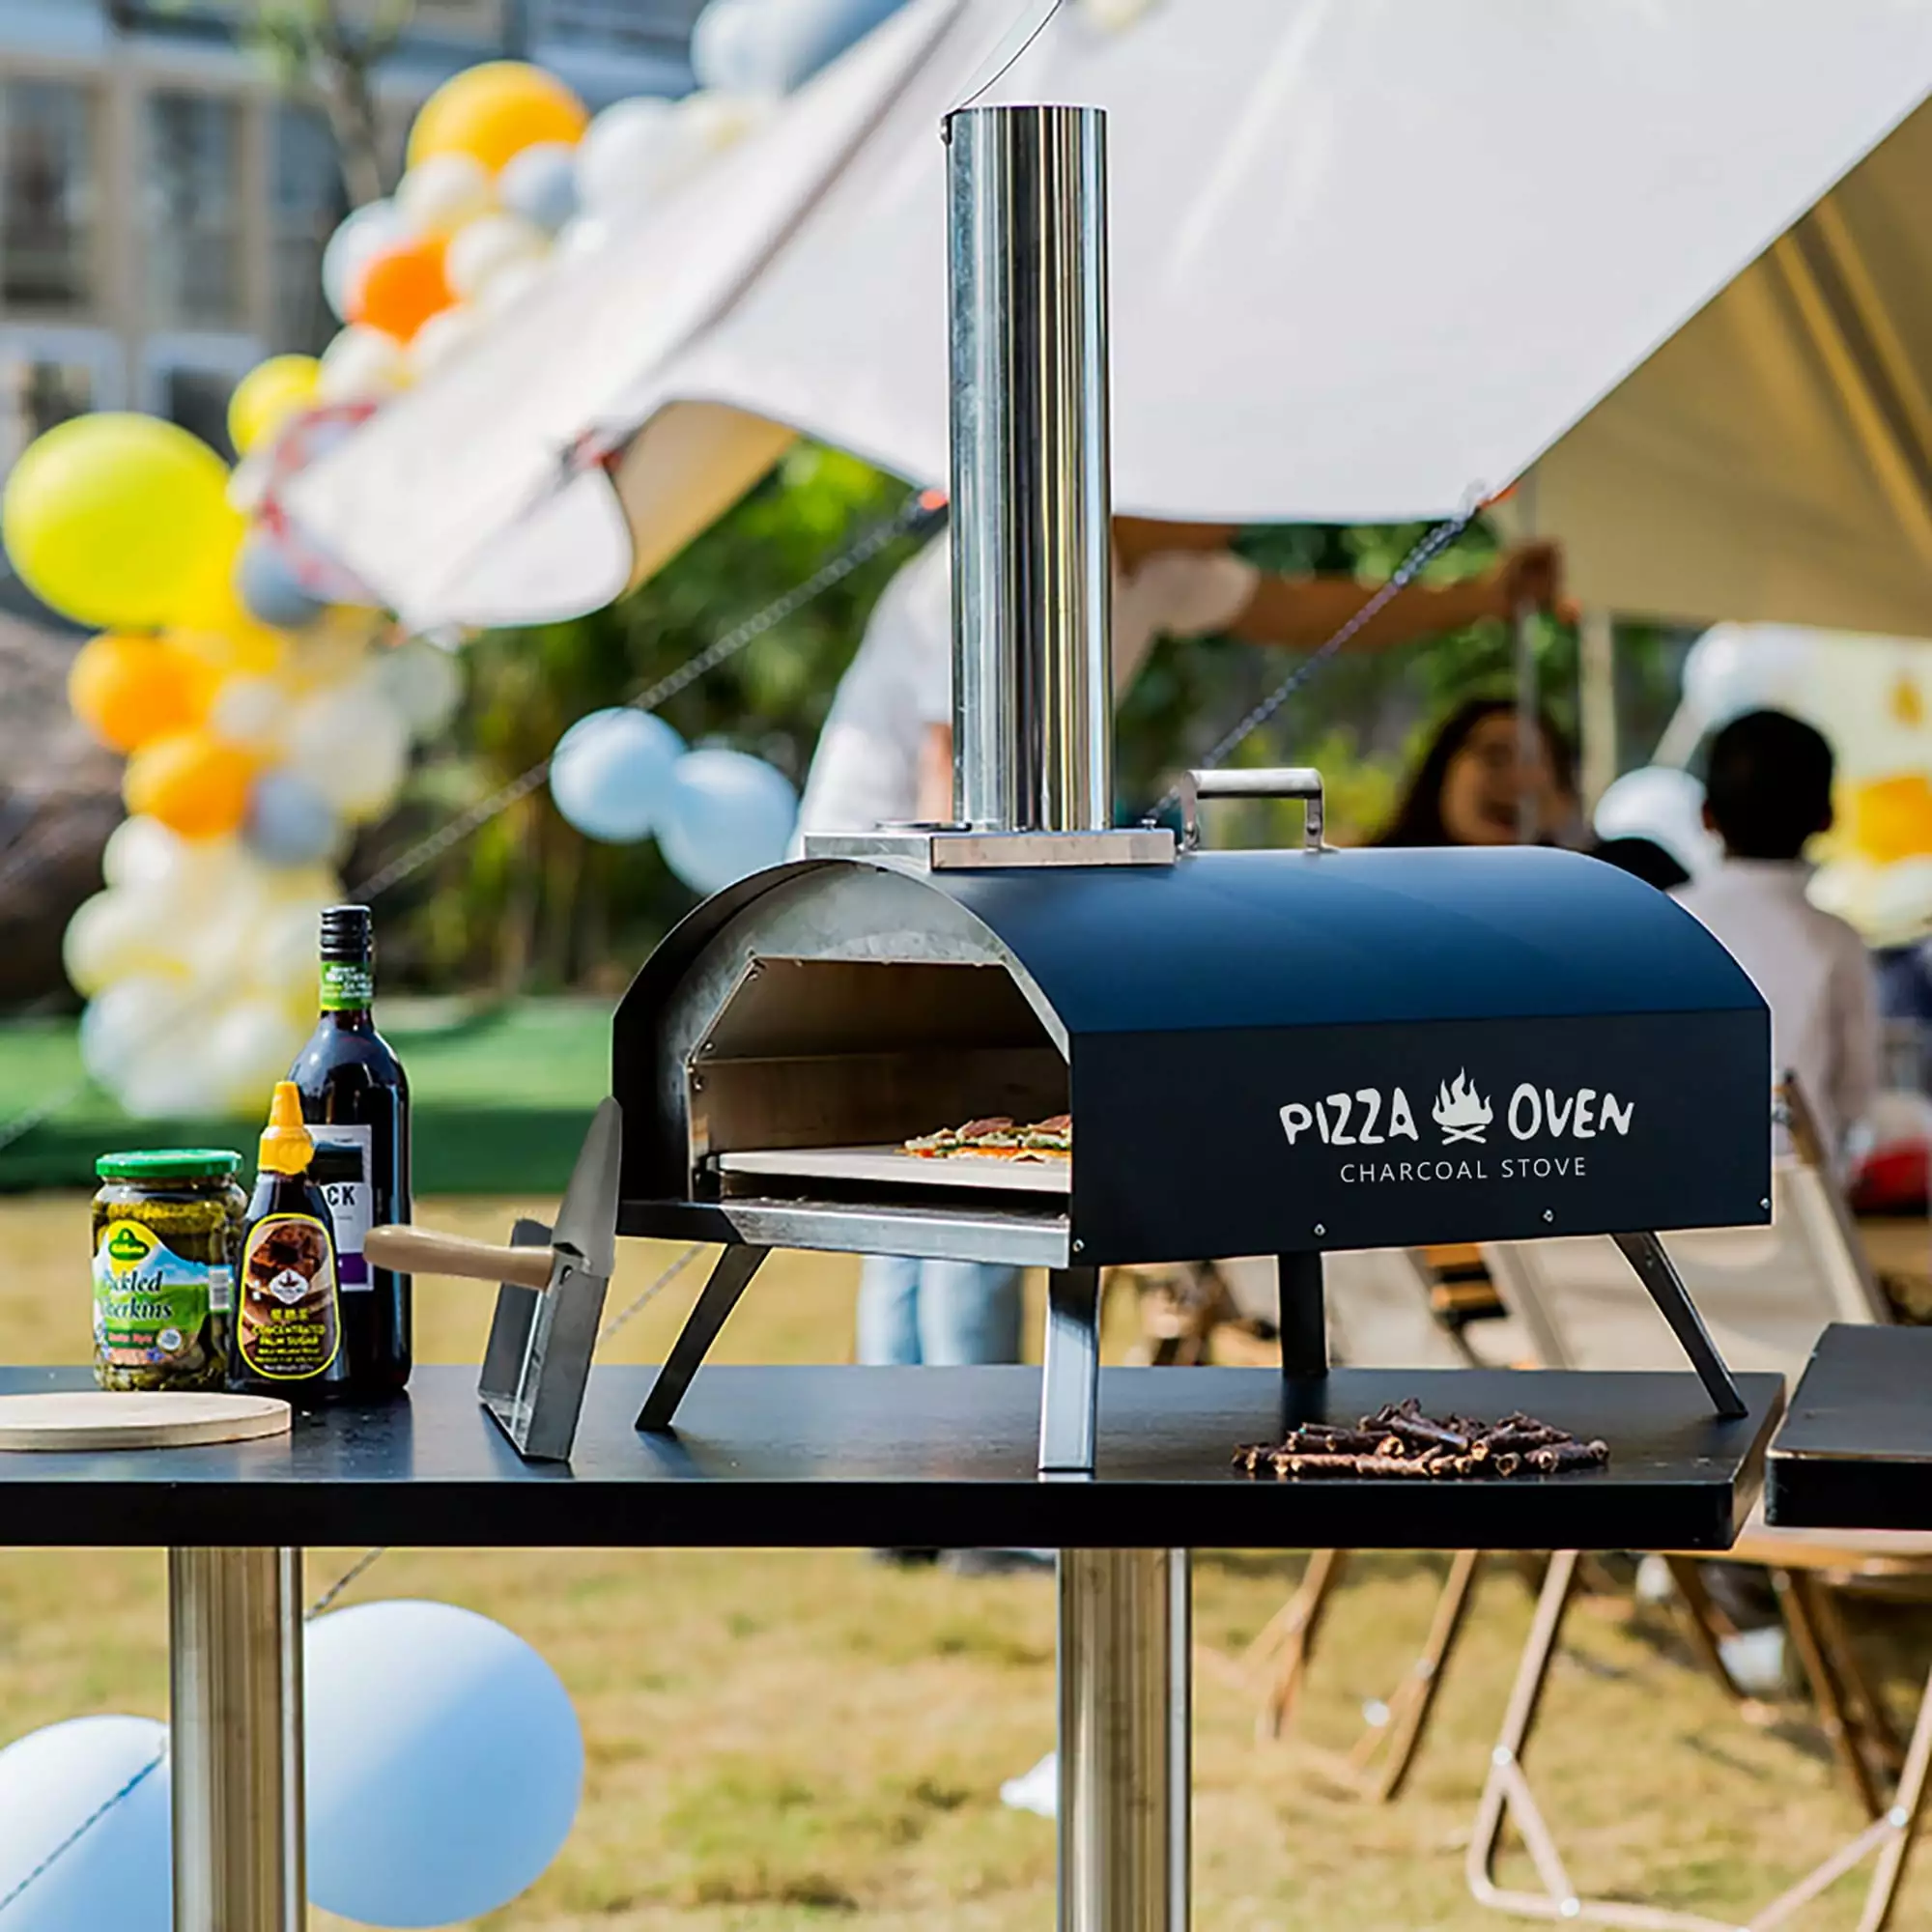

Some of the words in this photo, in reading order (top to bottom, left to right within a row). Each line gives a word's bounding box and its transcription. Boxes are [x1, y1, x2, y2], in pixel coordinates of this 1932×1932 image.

[1279, 1087, 1419, 1146] PIZZA
[1508, 1082, 1634, 1141] OVEN
[1340, 1160, 1488, 1183] CHARCOAL
[1501, 1156, 1586, 1179] STOVE
